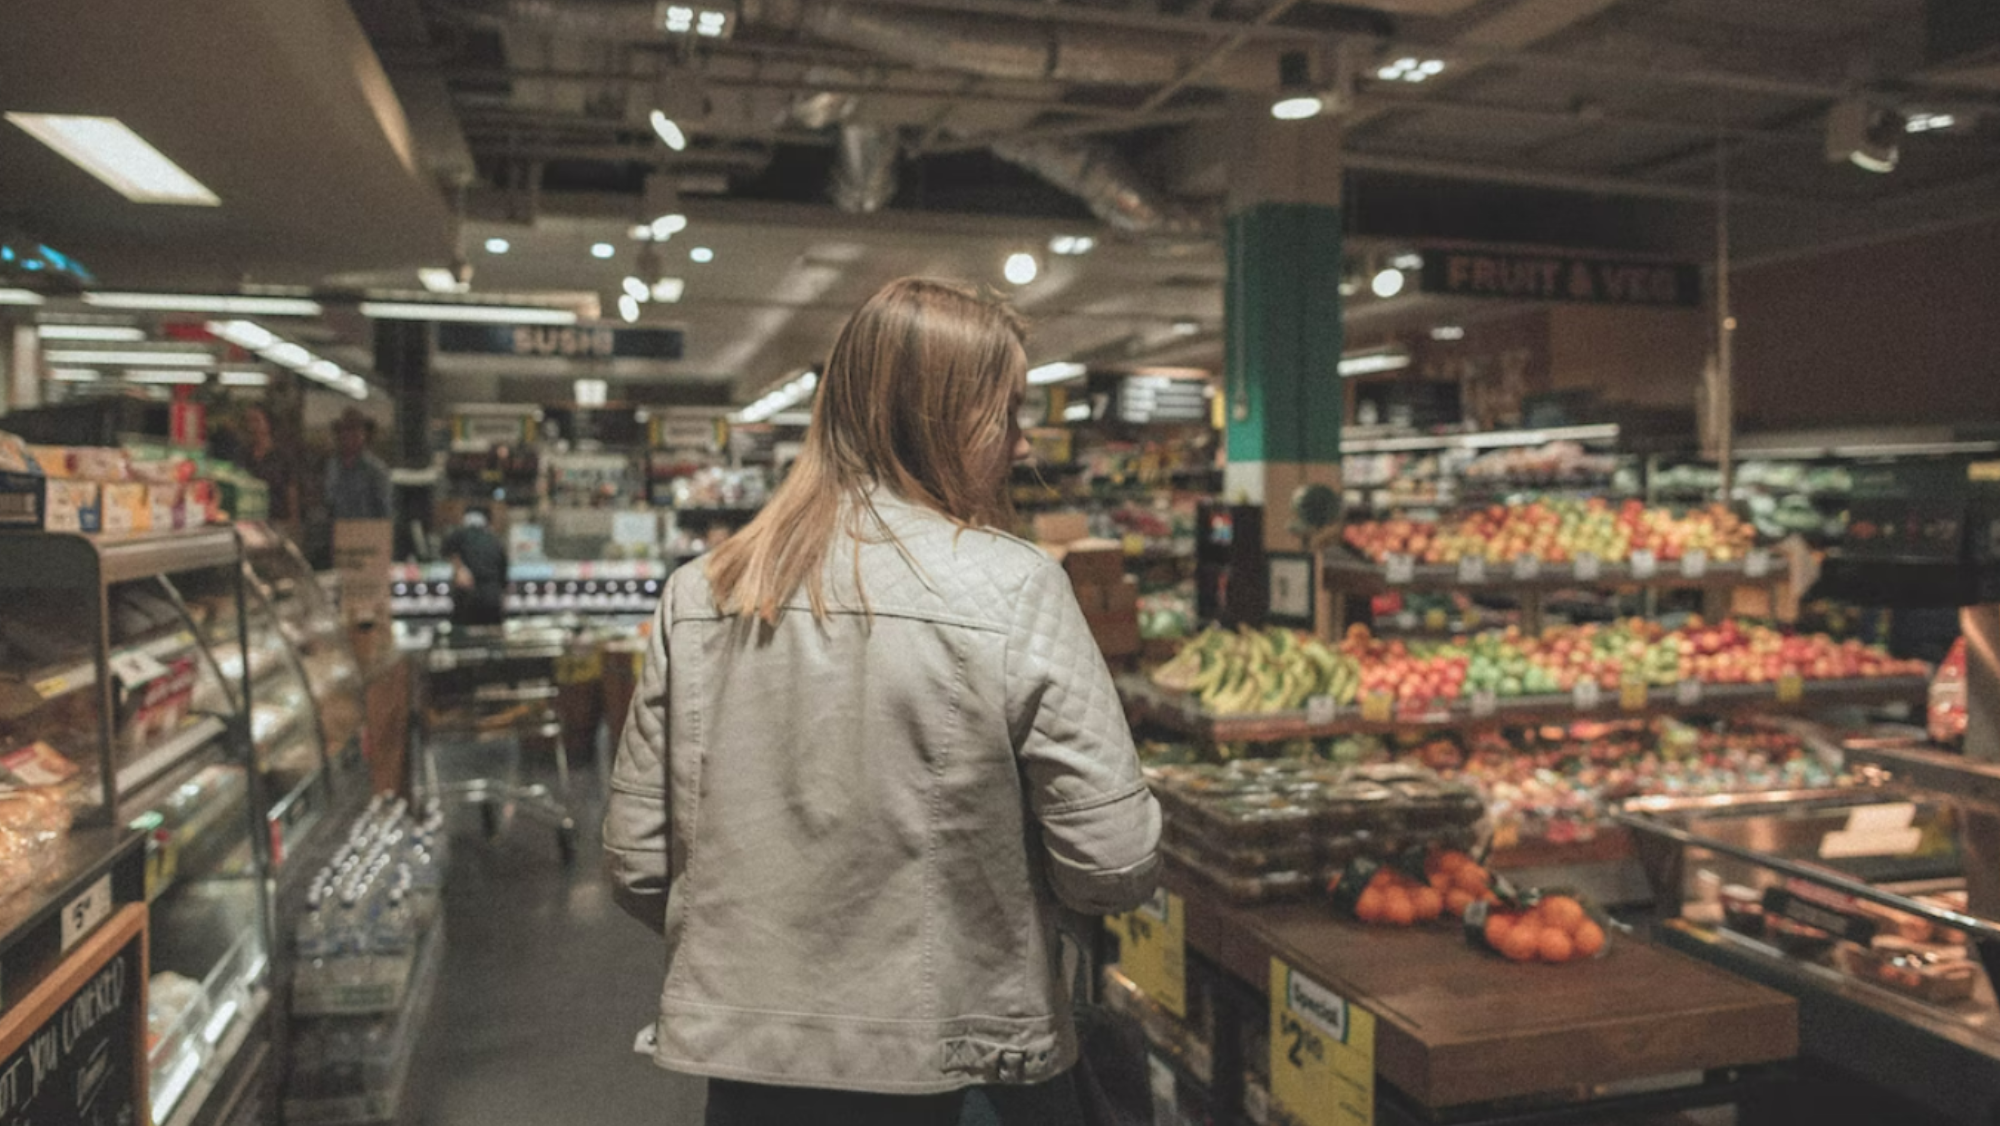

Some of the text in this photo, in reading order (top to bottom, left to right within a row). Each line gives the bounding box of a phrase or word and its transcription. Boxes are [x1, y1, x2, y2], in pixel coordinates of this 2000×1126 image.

[1447, 255, 1678, 301] FRUIT & VEG
[513, 325, 614, 355] SUSHI
[28, 1025, 59, 1098] YOU
[62, 956, 125, 1055] COVERED
[1293, 980, 1340, 1030] Special
